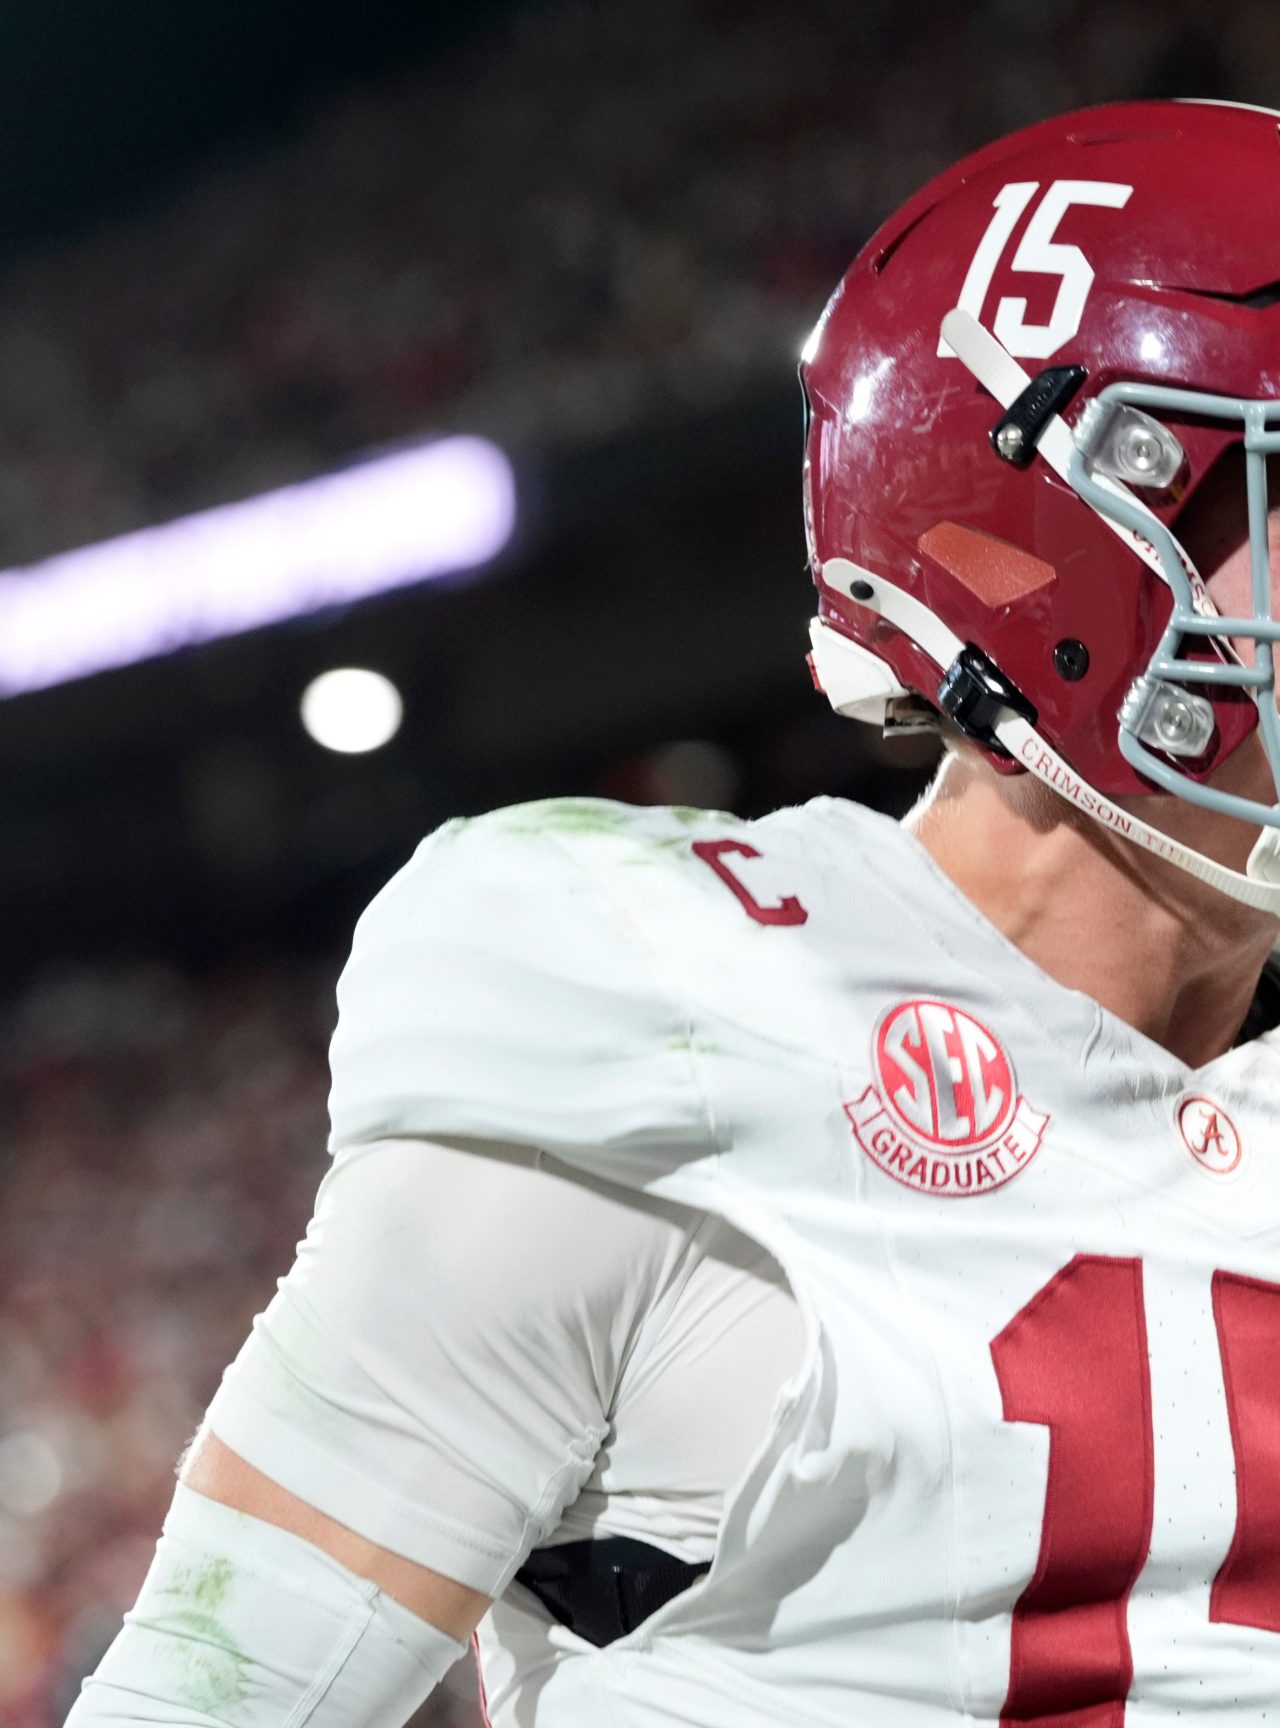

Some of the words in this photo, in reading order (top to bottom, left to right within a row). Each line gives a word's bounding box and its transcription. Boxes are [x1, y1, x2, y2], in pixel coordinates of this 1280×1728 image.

[936, 180, 1135, 359] 15
[1020, 737, 1133, 834] CRIMSON
[691, 839, 808, 926] C
[884, 1003, 1005, 1141] SEC
[871, 1128, 1027, 1188] GRADUATE
[1191, 1108, 1229, 1156] A
